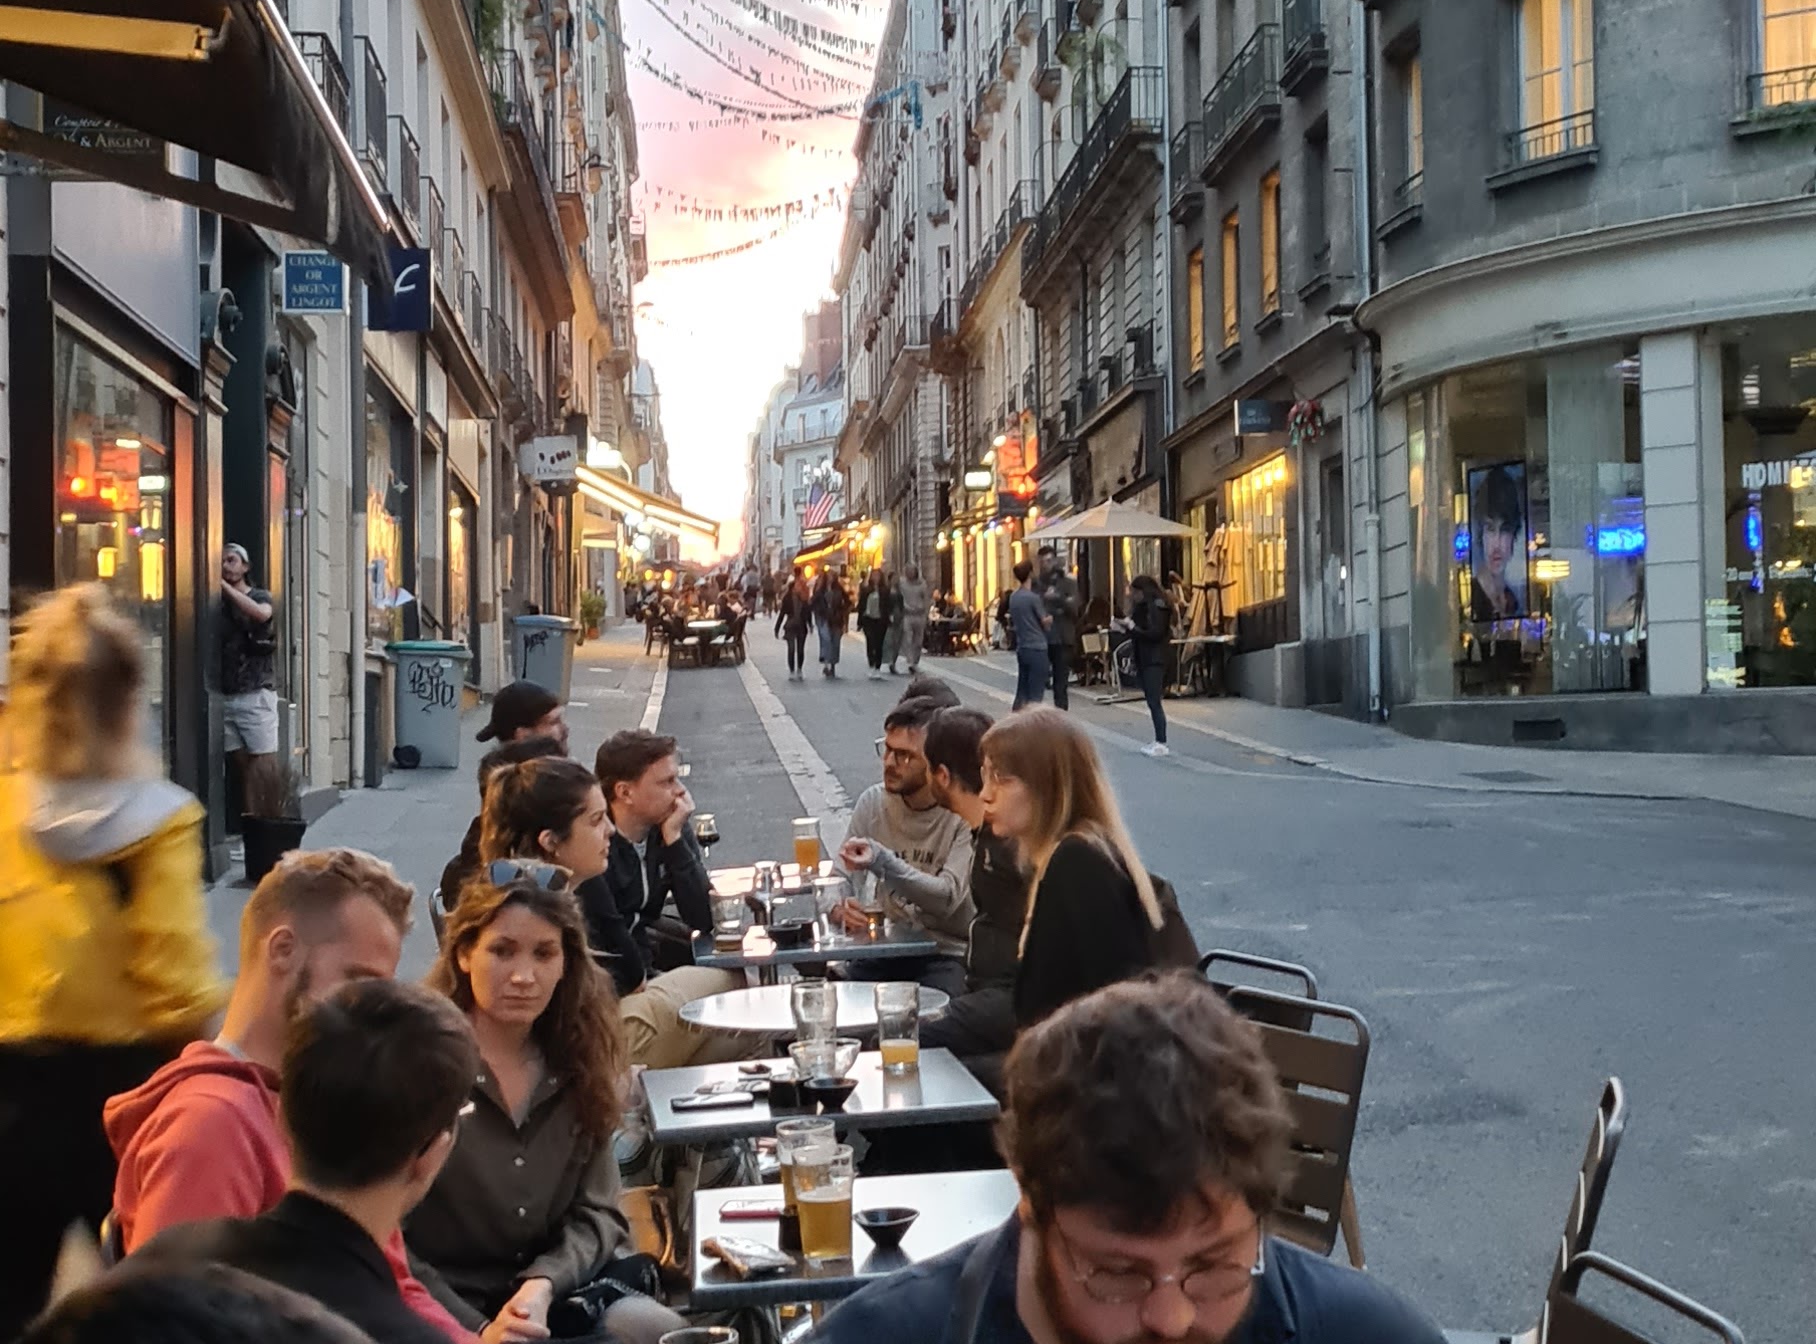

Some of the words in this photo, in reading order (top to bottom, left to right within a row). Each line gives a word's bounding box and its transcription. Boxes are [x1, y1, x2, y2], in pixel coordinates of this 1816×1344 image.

[80, 137, 92, 148] &
[305, 269, 323, 281] OR
[292, 283, 337, 294] ARGENT
[291, 297, 337, 307] LINGOT
